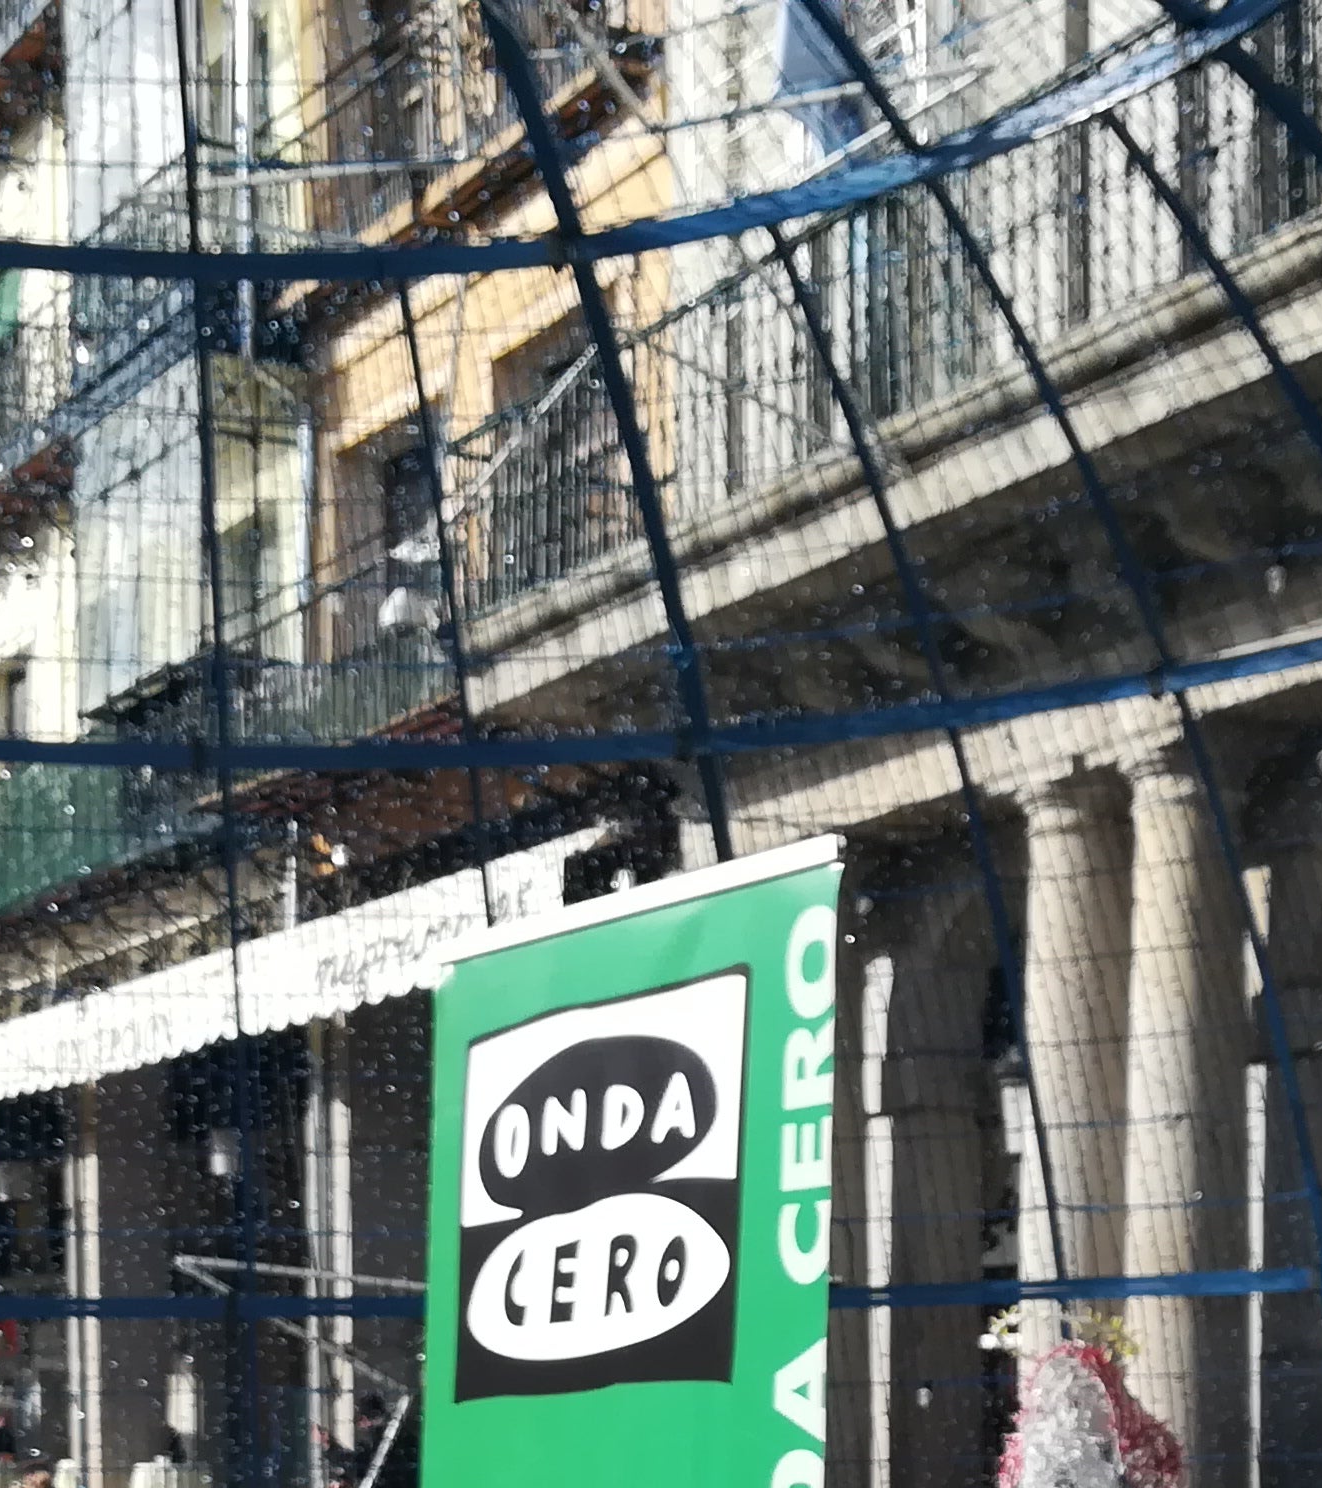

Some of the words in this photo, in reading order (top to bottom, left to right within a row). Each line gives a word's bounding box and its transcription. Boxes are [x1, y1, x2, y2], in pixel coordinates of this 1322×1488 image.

[493, 1071, 696, 1179] ONDA
[779, 905, 836, 1284] CERO
[504, 1234, 688, 1327] CERO
